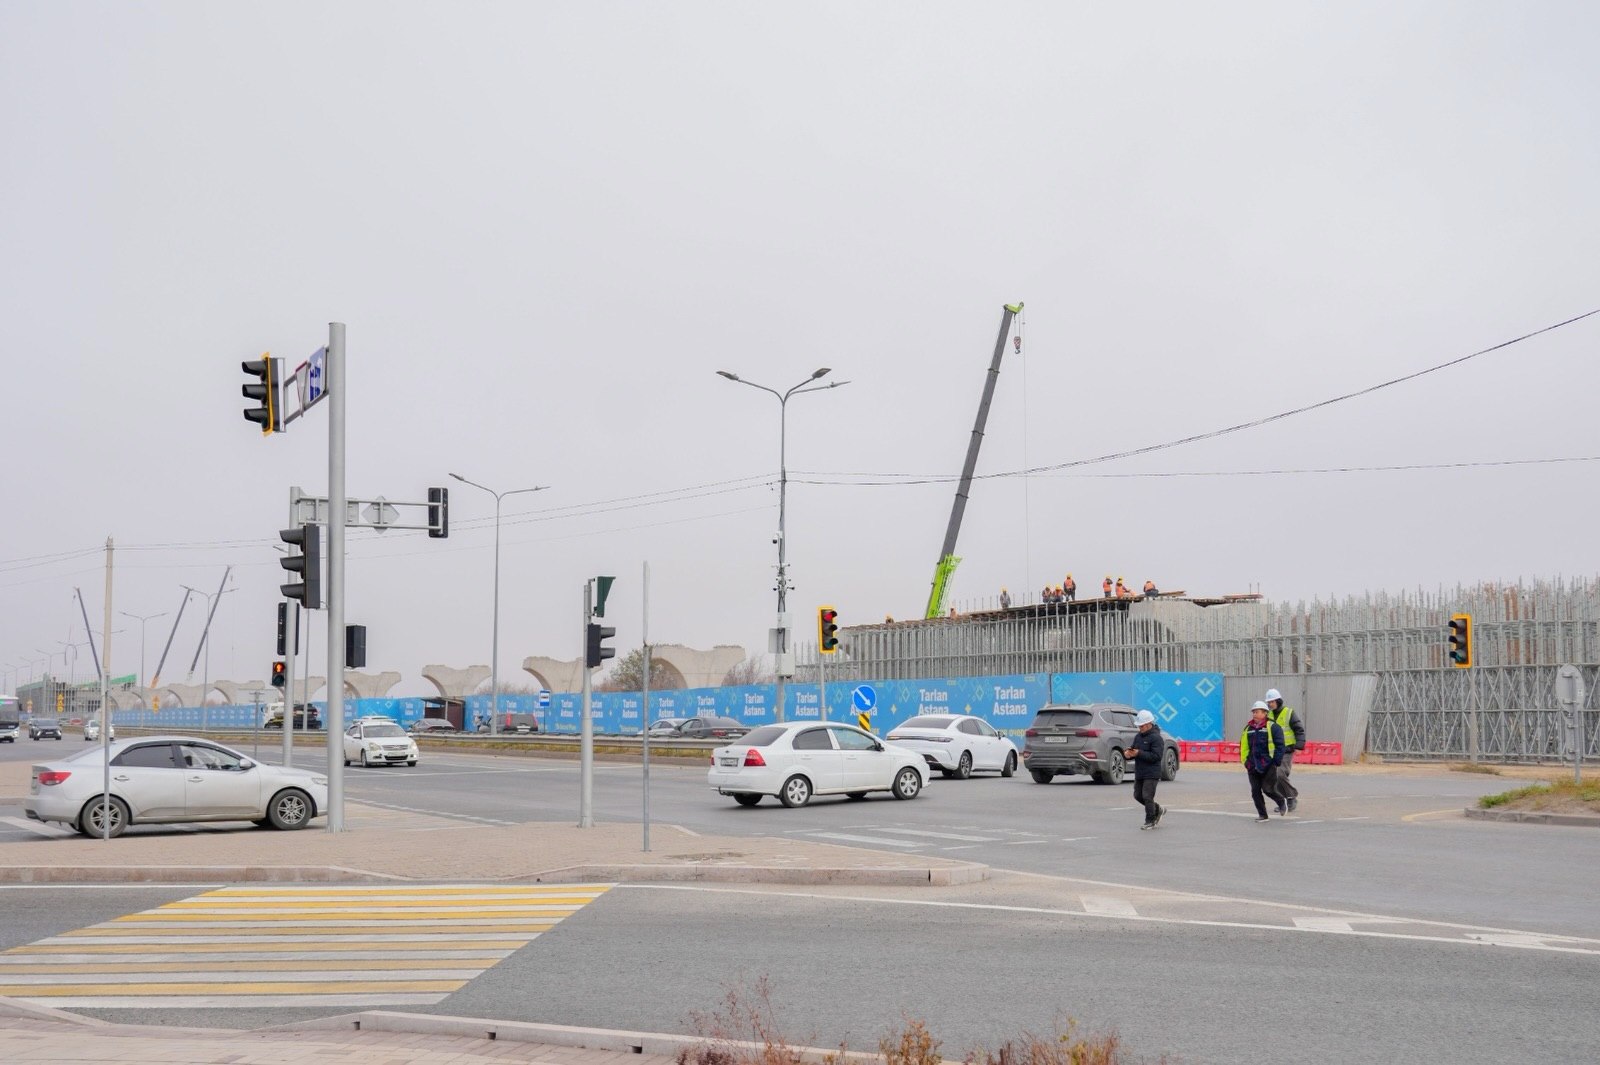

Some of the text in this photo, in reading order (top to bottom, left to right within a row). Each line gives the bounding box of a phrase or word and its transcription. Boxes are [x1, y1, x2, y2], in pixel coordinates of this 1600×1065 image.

[796, 692, 817, 704] Tarlan
[920, 689, 948, 702] Tarlan
[994, 686, 1025, 700] Tarlan
[698, 696, 714, 706] Tarlan
[745, 694, 764, 704] Tarlan
[697, 708, 716, 716] Astana
[744, 706, 766, 716] Astana
[795, 706, 818, 716] Astana
[918, 704, 949, 715] Astana
[993, 702, 1027, 715] Astana
